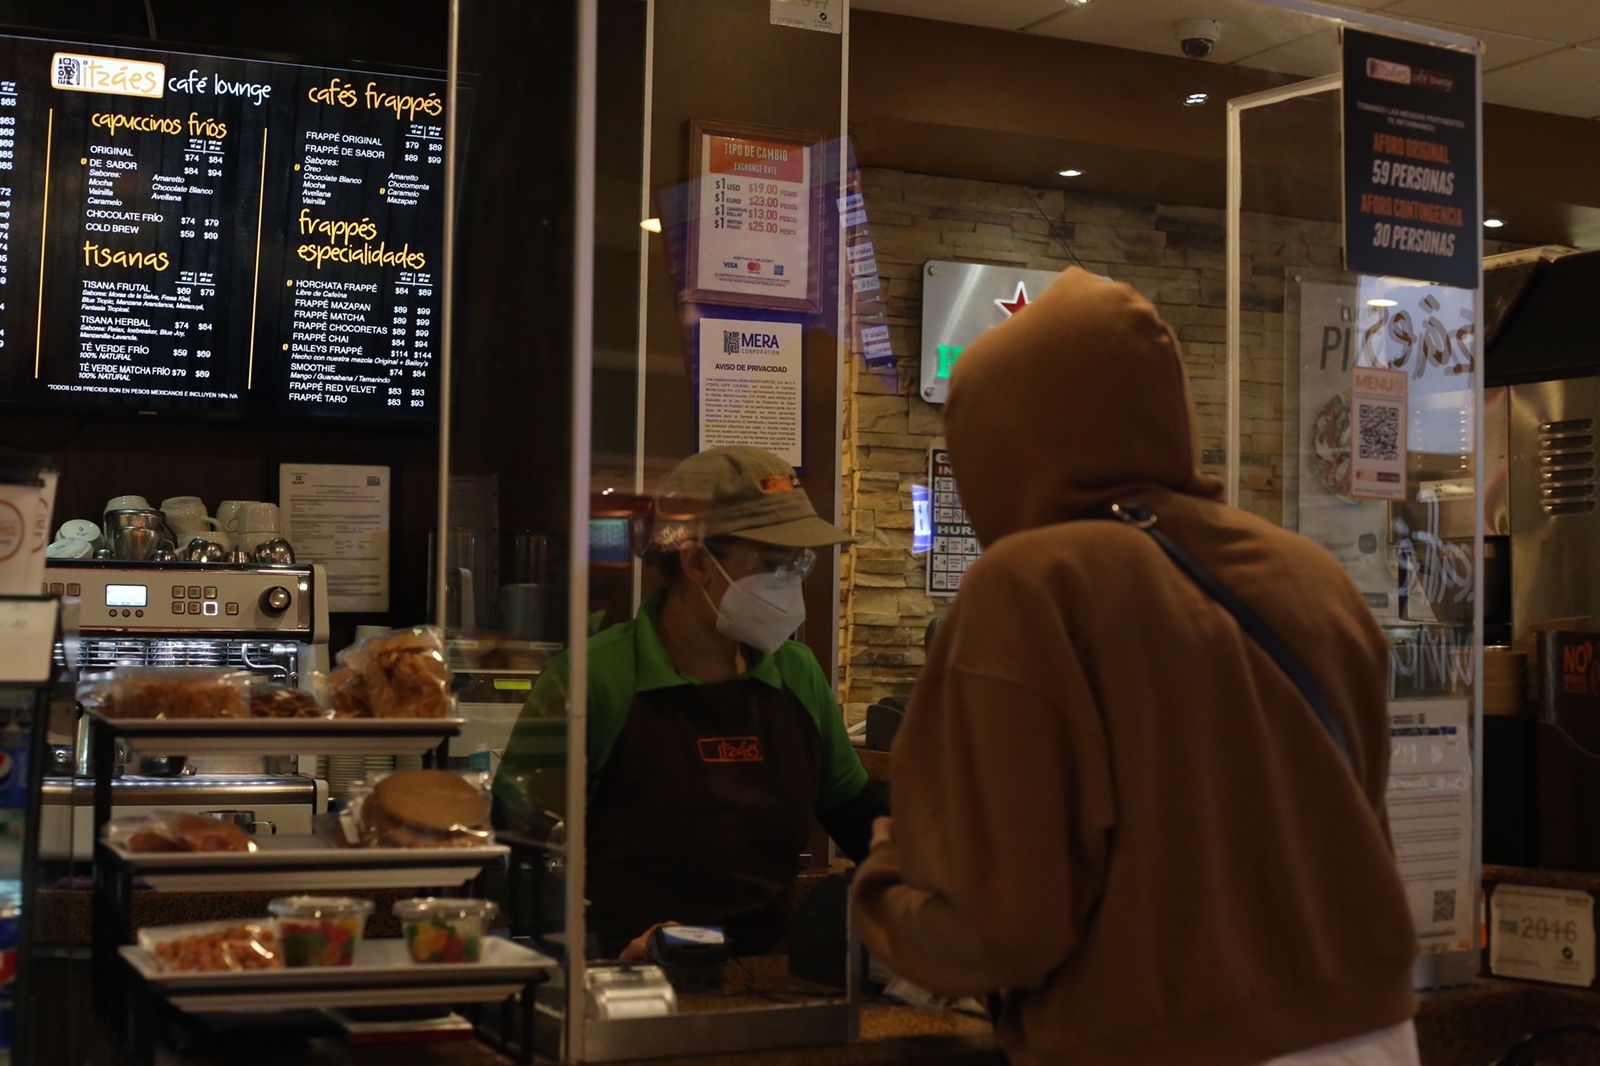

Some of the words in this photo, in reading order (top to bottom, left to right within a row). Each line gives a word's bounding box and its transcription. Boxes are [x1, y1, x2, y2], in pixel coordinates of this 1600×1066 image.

[83, 59, 157, 93] itzáes
[168, 69, 208, 94] café
[214, 73, 271, 106] lounge
[1, 98, 16, 106] $65
[308, 78, 357, 107] cafés
[365, 82, 443, 121] frappés
[91, 112, 182, 138] capuccinos
[188, 112, 227, 139] fríos
[306, 131, 340, 142] FRAPPÉ
[342, 135, 382, 146] ORIGINAL
[405, 141, 419, 149] $79
[1373, 132, 1404, 156] AFORO
[1406, 137, 1451, 164] ORIGINAL
[90, 146, 134, 156] ORIGINAL
[185, 154, 200, 162] $74
[208, 155, 223, 164] $84
[305, 144, 339, 155] FRAPPÉ
[341, 148, 353, 157] DE
[355, 149, 385, 159] SABOR
[404, 154, 418, 162] $89
[427, 156, 441, 164] $99
[724, 143, 743, 156] TIPO
[744, 146, 755, 157] DE
[757, 147, 788, 162] CAMBIO
[90, 159, 102, 168] DE
[106, 160, 138, 170] SABOR
[184, 167, 199, 175] $84
[207, 169, 222, 177] $94
[304, 165, 321, 173] Oreo
[305, 156, 340, 166] Sabores:
[734, 162, 763, 174] EXCHANGE
[764, 165, 778, 175] RATE
[88, 178, 113, 187] Mocha
[303, 173, 337, 182] Chocolate
[339, 176, 362, 184] Blanco
[388, 173, 419, 181] Amaretto
[1371, 159, 1390, 185] 59
[1391, 162, 1455, 196] PERSONAS
[152, 184, 188, 193] Chocolate
[189, 186, 213, 195] Blanco
[302, 189, 331, 198] Avellana
[387, 189, 420, 197] Caramelo
[303, 181, 326, 189] Mocha
[388, 181, 430, 191] Chocomenta
[715, 178, 726, 190] $1
[727, 184, 740, 192] USD
[748, 183, 778, 195] $19.00
[87, 196, 122, 206] Caramelo
[151, 193, 182, 202] Avellana
[302, 197, 326, 205] Vainilla
[386, 197, 417, 206] Mazapan
[714, 191, 725, 203] $1
[749, 196, 779, 208] $23.00
[86, 209, 140, 221] CHOCOLATE
[142, 212, 163, 223] FRÍO
[181, 217, 196, 225] $74
[204, 218, 219, 226] $79
[714, 204, 725, 217] $1
[748, 209, 778, 222] $13.00
[1360, 192, 1393, 216] AFORO
[1393, 197, 1464, 228] CONTINGENCIA
[85, 223, 110, 232] COLD
[112, 224, 139, 234] BREW
[180, 230, 195, 238] $59
[204, 232, 218, 240] $69
[299, 208, 377, 245] frappés
[714, 217, 724, 230] $1
[748, 222, 778, 234] $25.00
[1372, 222, 1391, 248] 30
[1392, 225, 1456, 257] PERSONAS
[83, 240, 170, 272] tisanas
[297, 241, 426, 270] especialidades
[83, 280, 116, 290] TISANA
[117, 282, 151, 292] FRUTAL
[176, 287, 191, 295] $69
[296, 280, 342, 290] HORCHATA
[344, 283, 378, 293] FRAPPÉ
[395, 287, 408, 295] $84
[418, 288, 432, 296] $89
[295, 299, 329, 309] FRAPPÉ
[330, 302, 371, 311] MAZAPAN
[394, 306, 408, 314] $89
[416, 307, 430, 316] $99
[81, 315, 114, 325] TISANA
[115, 317, 151, 327] HERBAL
[174, 321, 189, 329] $74
[198, 323, 213, 331] $84
[294, 310, 328, 320] FRAPPÉ
[330, 313, 365, 322] MATCHA
[393, 317, 407, 325] $89
[416, 318, 430, 326] $99
[293, 321, 327, 331] FRAPPÉ
[329, 324, 388, 335] CHOCORETAS
[392, 328, 406, 336] $89
[415, 329, 429, 337] $99
[292, 332, 327, 342] FRAPPÉ
[328, 335, 349, 343] CHAI
[391, 339, 405, 347] $84
[414, 340, 428, 348] $94
[742, 333, 779, 348] MERA
[81, 343, 92, 351] TÉ
[95, 344, 126, 353] VERDE
[128, 345, 150, 354] FRÍO
[173, 349, 188, 357] $59
[292, 344, 327, 353] BAILEYS
[329, 345, 363, 355] FRAPPÉ
[390, 350, 408, 358] $114
[414, 351, 432, 359] $144
[80, 363, 90, 372] TÉ
[91, 364, 118, 373] VERDE
[119, 366, 151, 375] MATCHA
[152, 366, 171, 376] FRÍO
[290, 363, 336, 372] SMOOTHIE
[389, 369, 403, 377] $74
[412, 370, 426, 378] $84
[715, 363, 735, 371] AVISO
[748, 365, 787, 373] PRIVACIDAD
[290, 372, 311, 381] Mango
[289, 382, 323, 392] FRAPPÉ
[325, 384, 343, 392] RED
[345, 385, 377, 394] VELVET
[388, 387, 402, 396] $83
[411, 388, 425, 396] $93
[288, 393, 322, 402] FRAPPÉ
[325, 395, 348, 403] TARO
[387, 398, 401, 406] $83
[410, 399, 424, 407] $93
[1521, 916, 1577, 943] 2016
